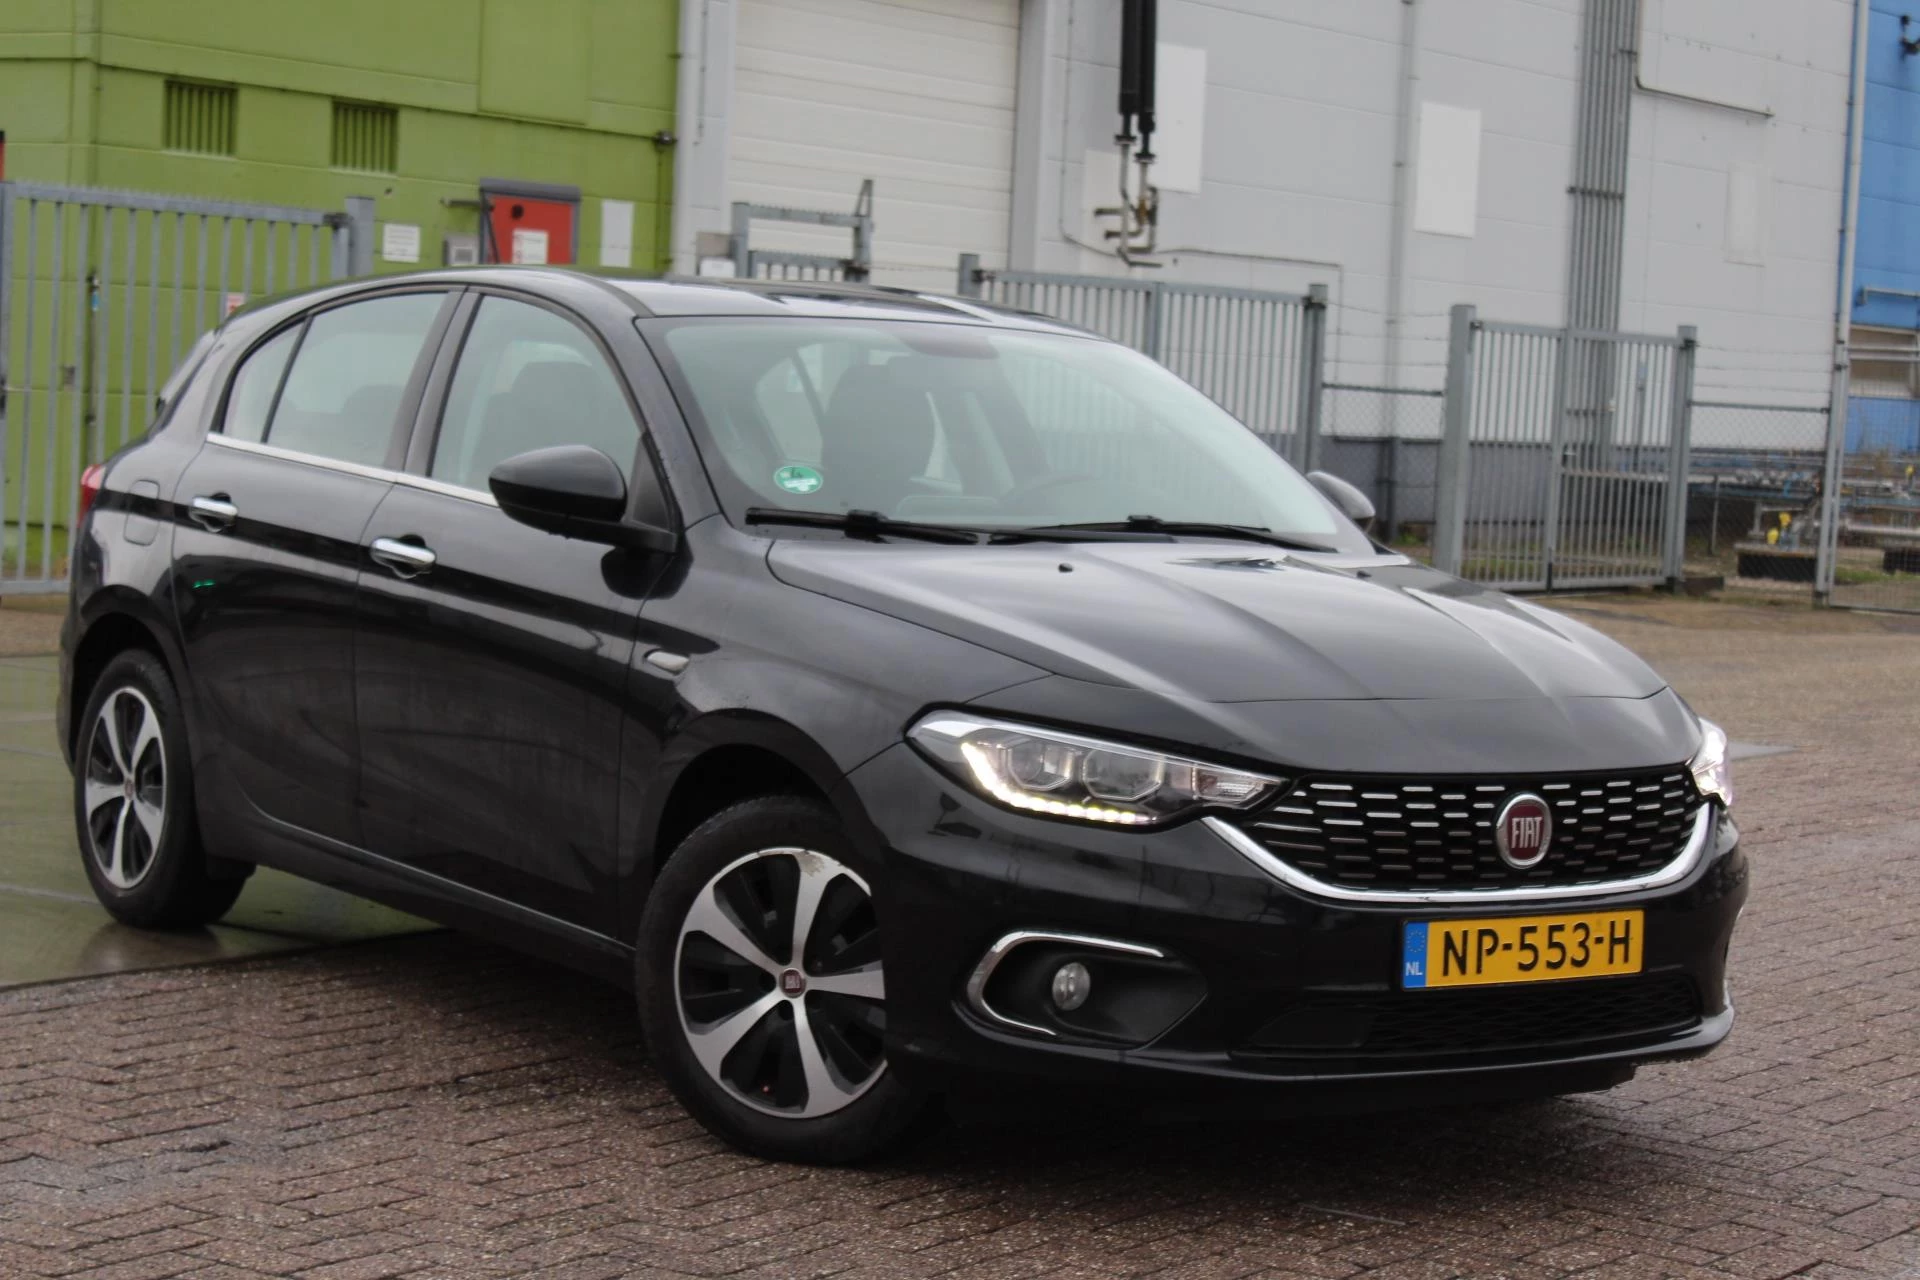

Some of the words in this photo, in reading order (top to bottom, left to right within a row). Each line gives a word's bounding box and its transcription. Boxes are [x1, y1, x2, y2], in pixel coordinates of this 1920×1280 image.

[1511, 816, 1543, 849] FIAT
[1442, 919, 1630, 976] NP-553-H
[1405, 962, 1423, 976] NL
